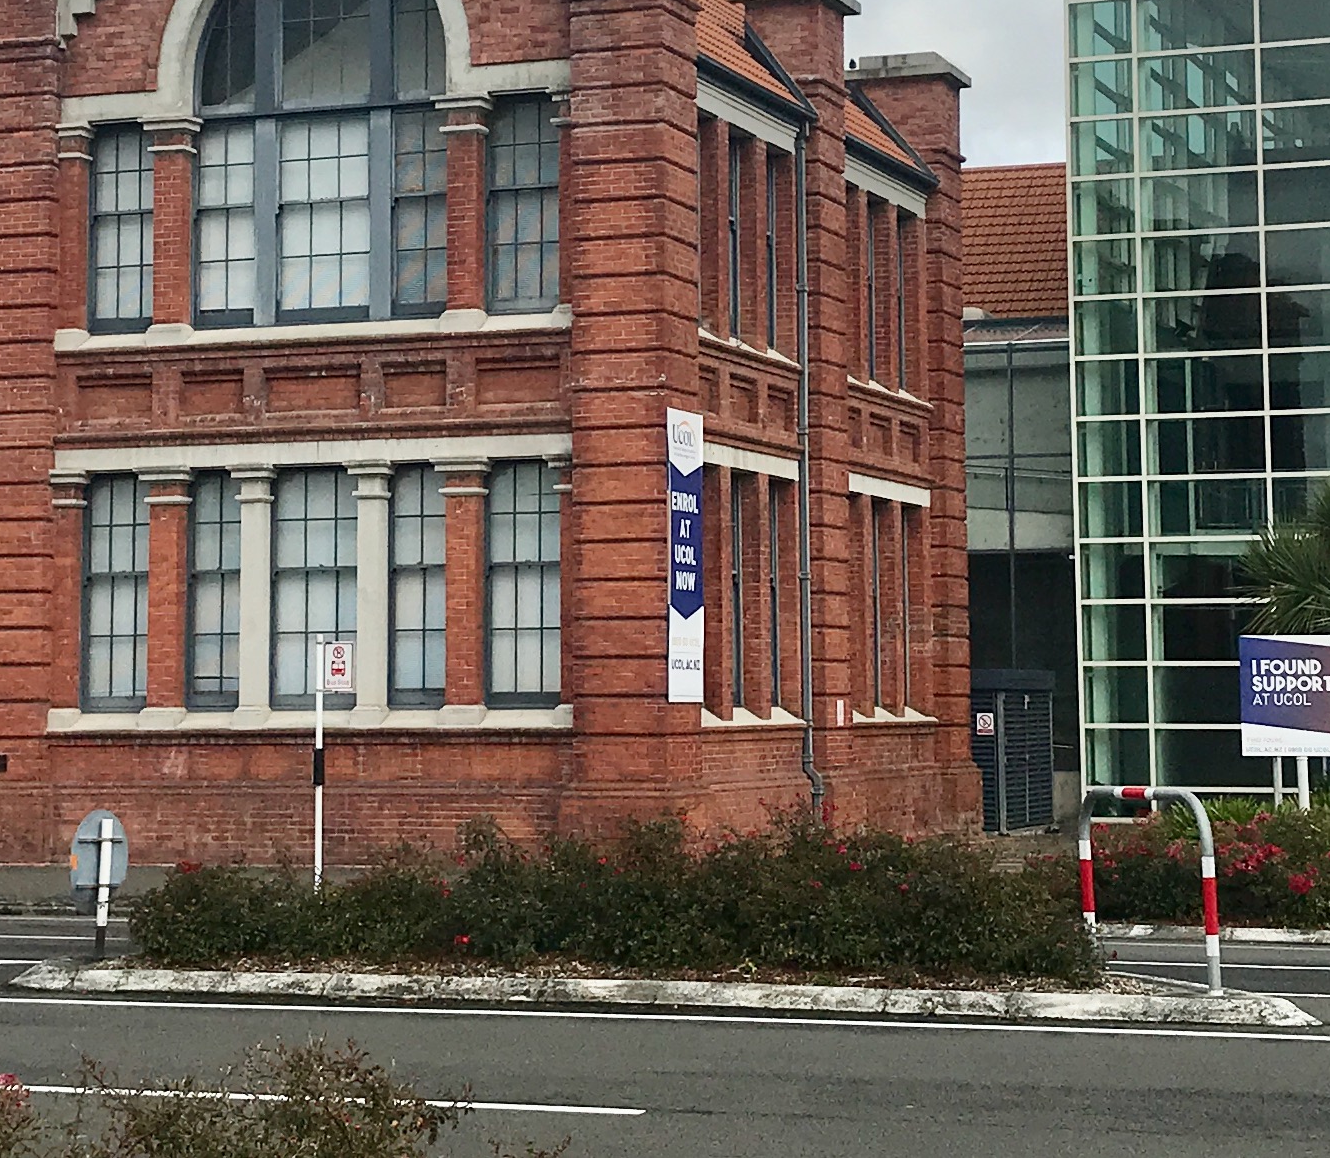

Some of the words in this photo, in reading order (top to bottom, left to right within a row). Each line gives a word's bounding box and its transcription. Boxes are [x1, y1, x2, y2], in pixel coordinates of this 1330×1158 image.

[671, 491, 699, 514] ENROL
[679, 518, 691, 538] AT
[674, 544, 697, 566] UCOL
[675, 570, 696, 592] NOW
[1251, 659, 1258, 675] I
[1260, 658, 1322, 675] FOUND
[1252, 693, 1271, 706] AT
[1273, 693, 1312, 706] UCOL
